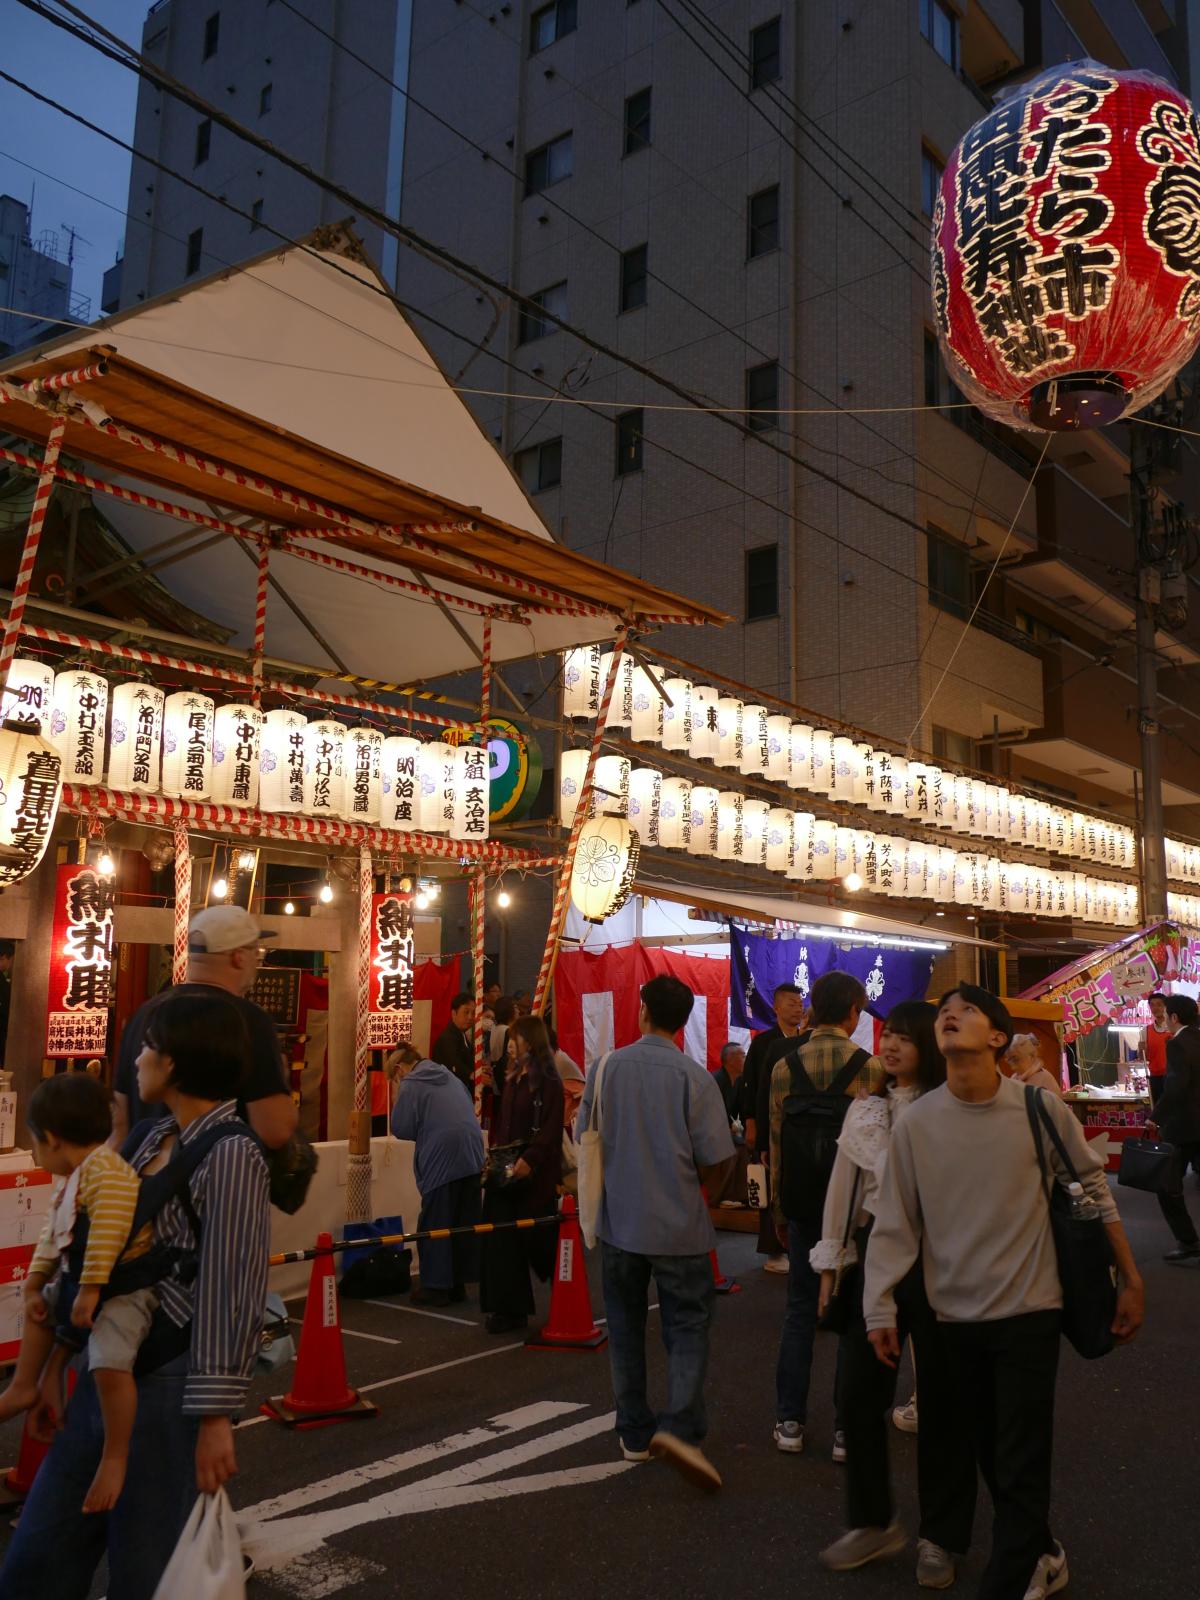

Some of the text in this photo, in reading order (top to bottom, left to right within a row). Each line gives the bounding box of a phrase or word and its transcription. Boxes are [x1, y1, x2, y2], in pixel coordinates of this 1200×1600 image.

[394, 756, 415, 821] 明治座
[879, 756, 893, 804] 松阪市
